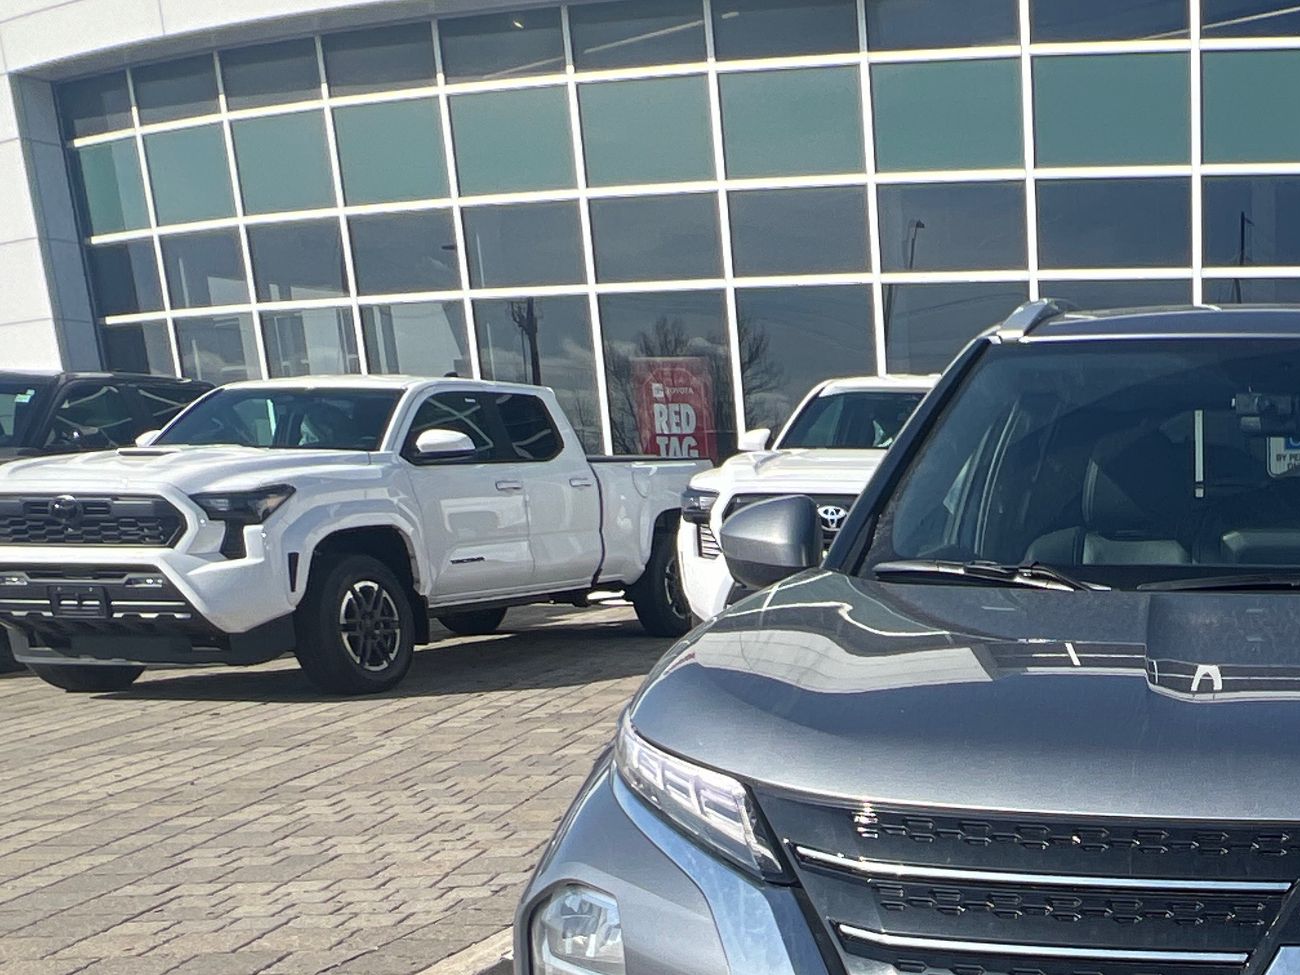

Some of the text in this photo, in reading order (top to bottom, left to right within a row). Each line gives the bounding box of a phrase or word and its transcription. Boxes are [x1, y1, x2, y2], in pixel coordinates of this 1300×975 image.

[653, 403, 697, 434] RED
[656, 436, 699, 458] TAG
[1276, 453, 1287, 462] BY
